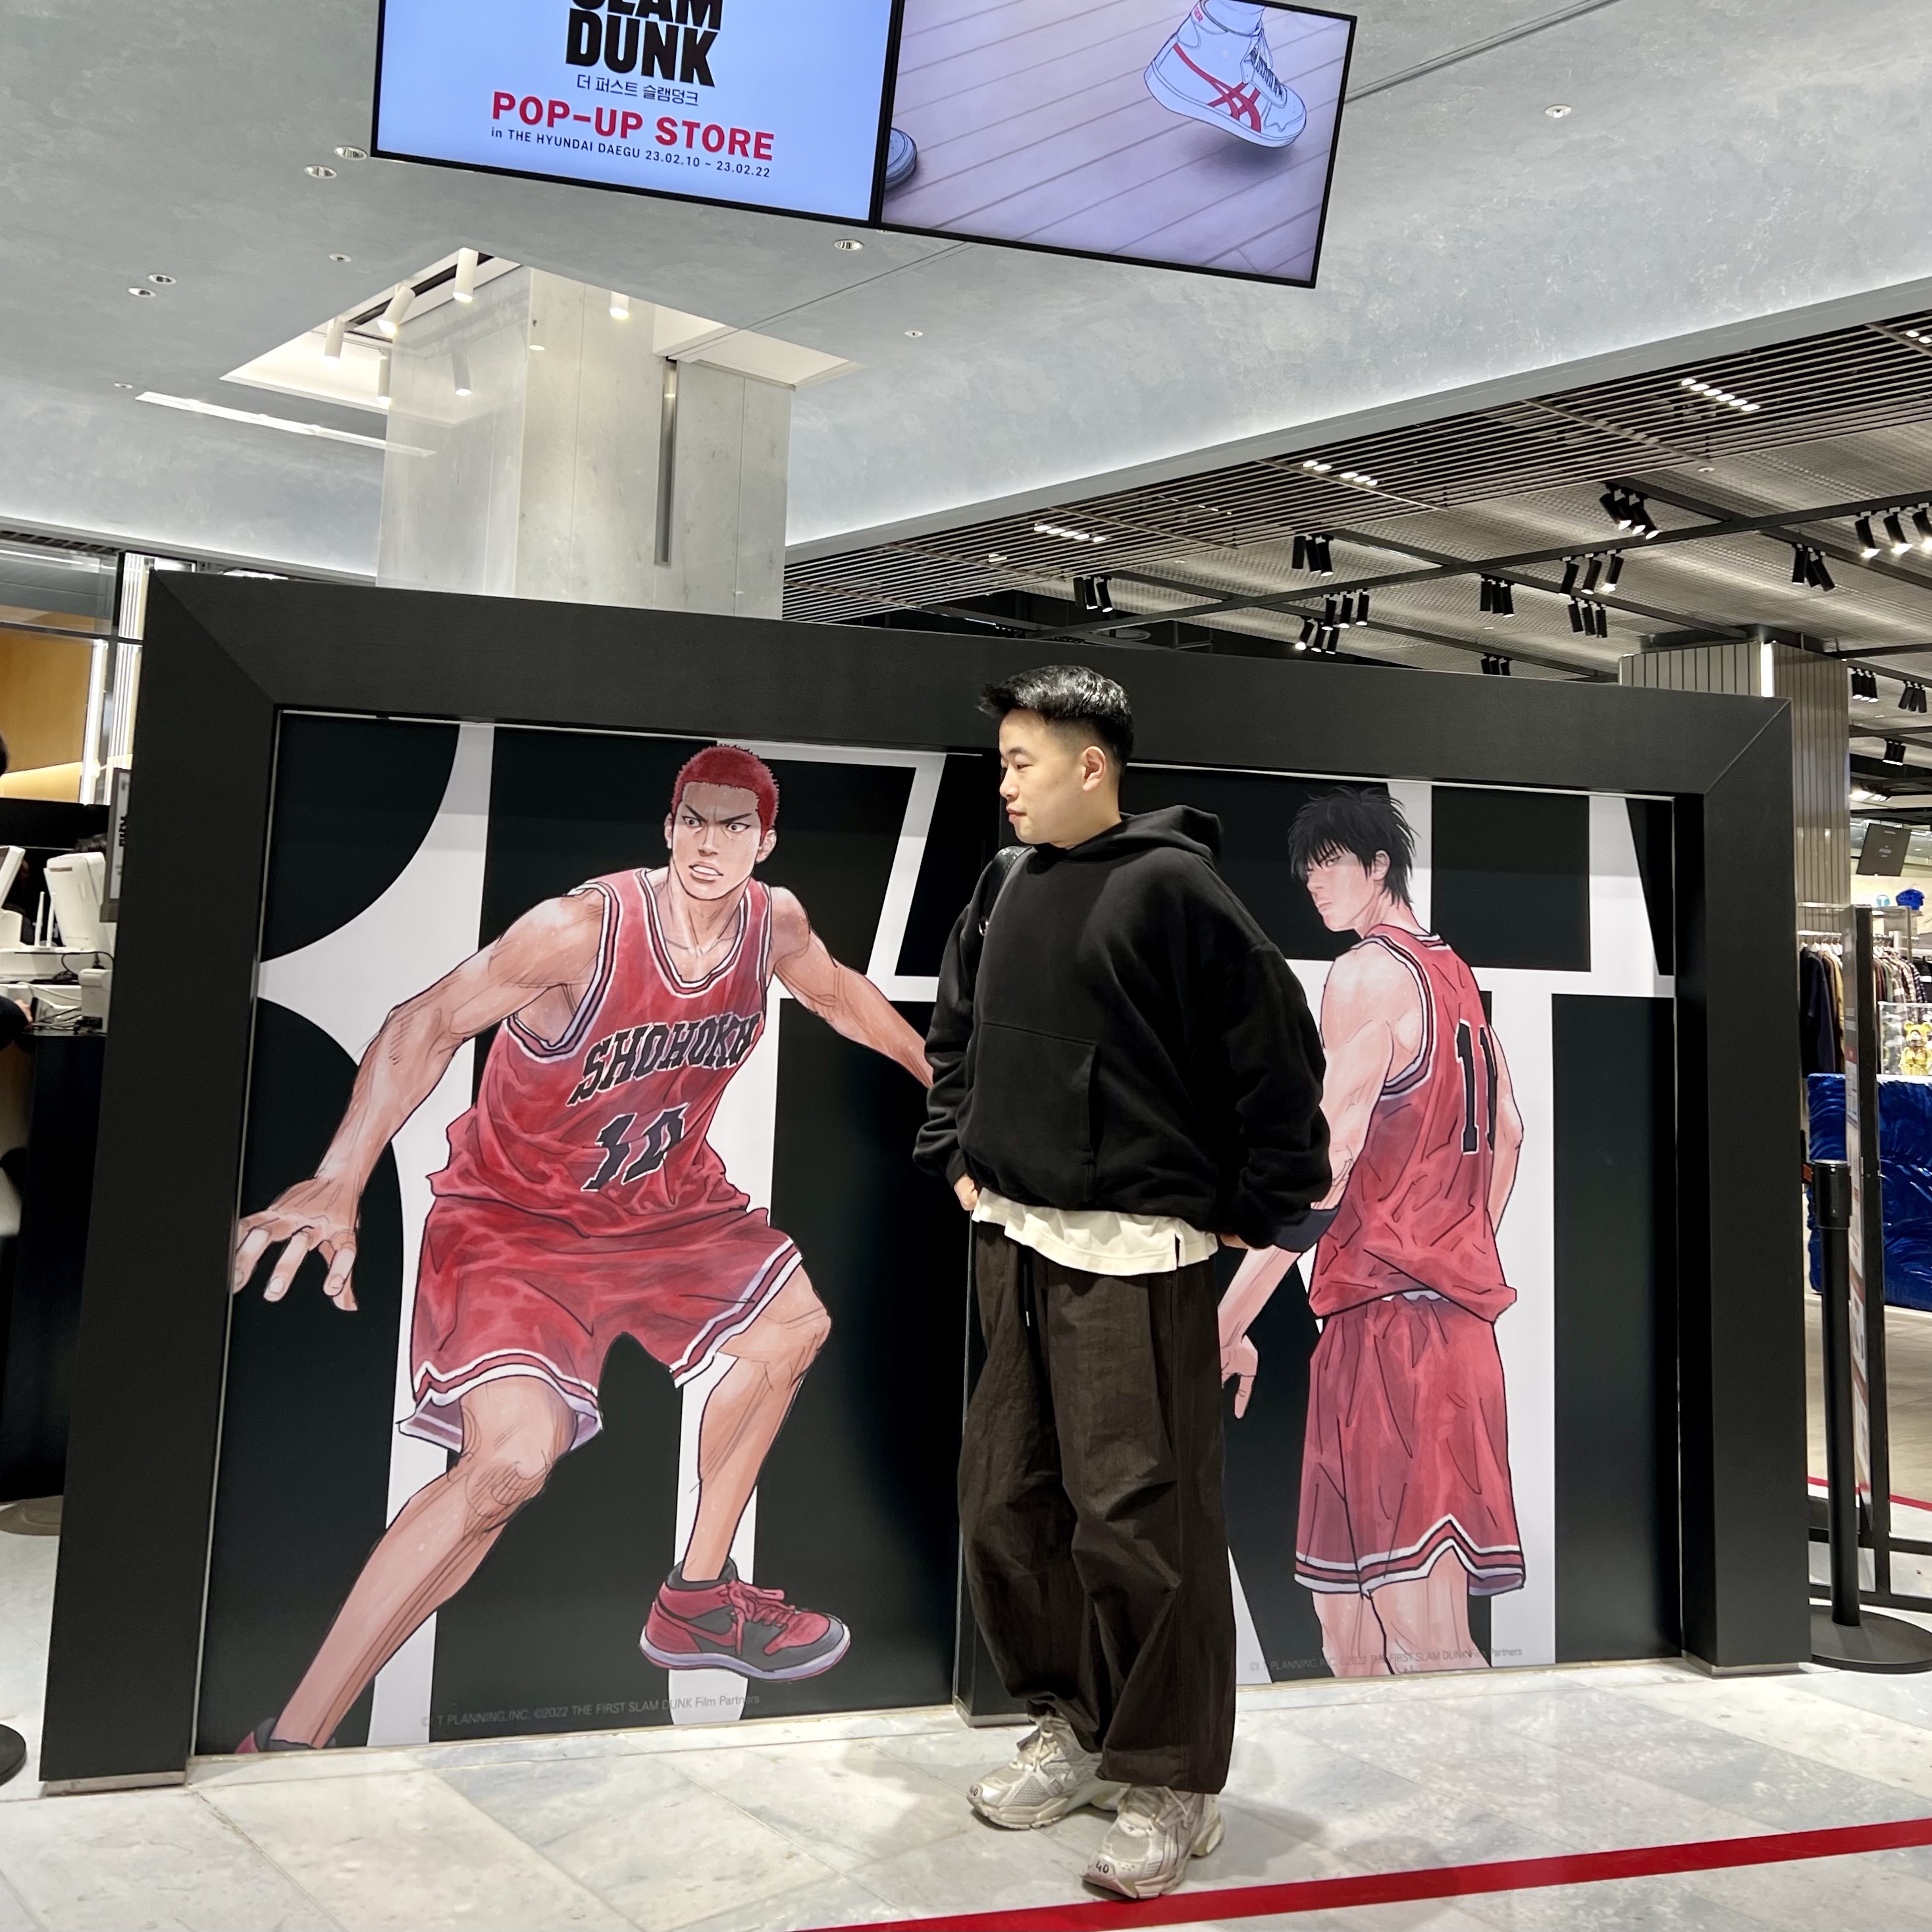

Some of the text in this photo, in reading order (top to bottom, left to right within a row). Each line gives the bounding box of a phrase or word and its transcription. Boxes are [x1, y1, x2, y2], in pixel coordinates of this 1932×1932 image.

[565, 8, 717, 88] DUNK
[577, 74, 698, 106] 더 퍼스트 슬램덩크
[492, 91, 774, 161] POP-UP STORE
[491, 127, 502, 138] in
[508, 130, 531, 142] THE
[536, 134, 592, 151] HYUNDAI
[598, 143, 640, 158] DAEGU
[645, 150, 700, 167] 23.02.10
[716, 161, 770, 178] 23.02.22
[566, 1011, 765, 1107] SHOHOKU
[1455, 1018, 1498, 1155] 11
[581, 1103, 690, 1192] 10
[1390, 1653, 1414, 1662] FIRST
[1417, 1651, 1440, 1661] SLAM
[571, 1704, 592, 1716] THE
[595, 1702, 626, 1715] FIRST
[628, 1698, 659, 1713] SLAM
[661, 1697, 692, 1710] DUNK
[694, 1695, 716, 1708] Film
[969, 1783, 979, 1797] 40
[1095, 1860, 1110, 1874] 40
